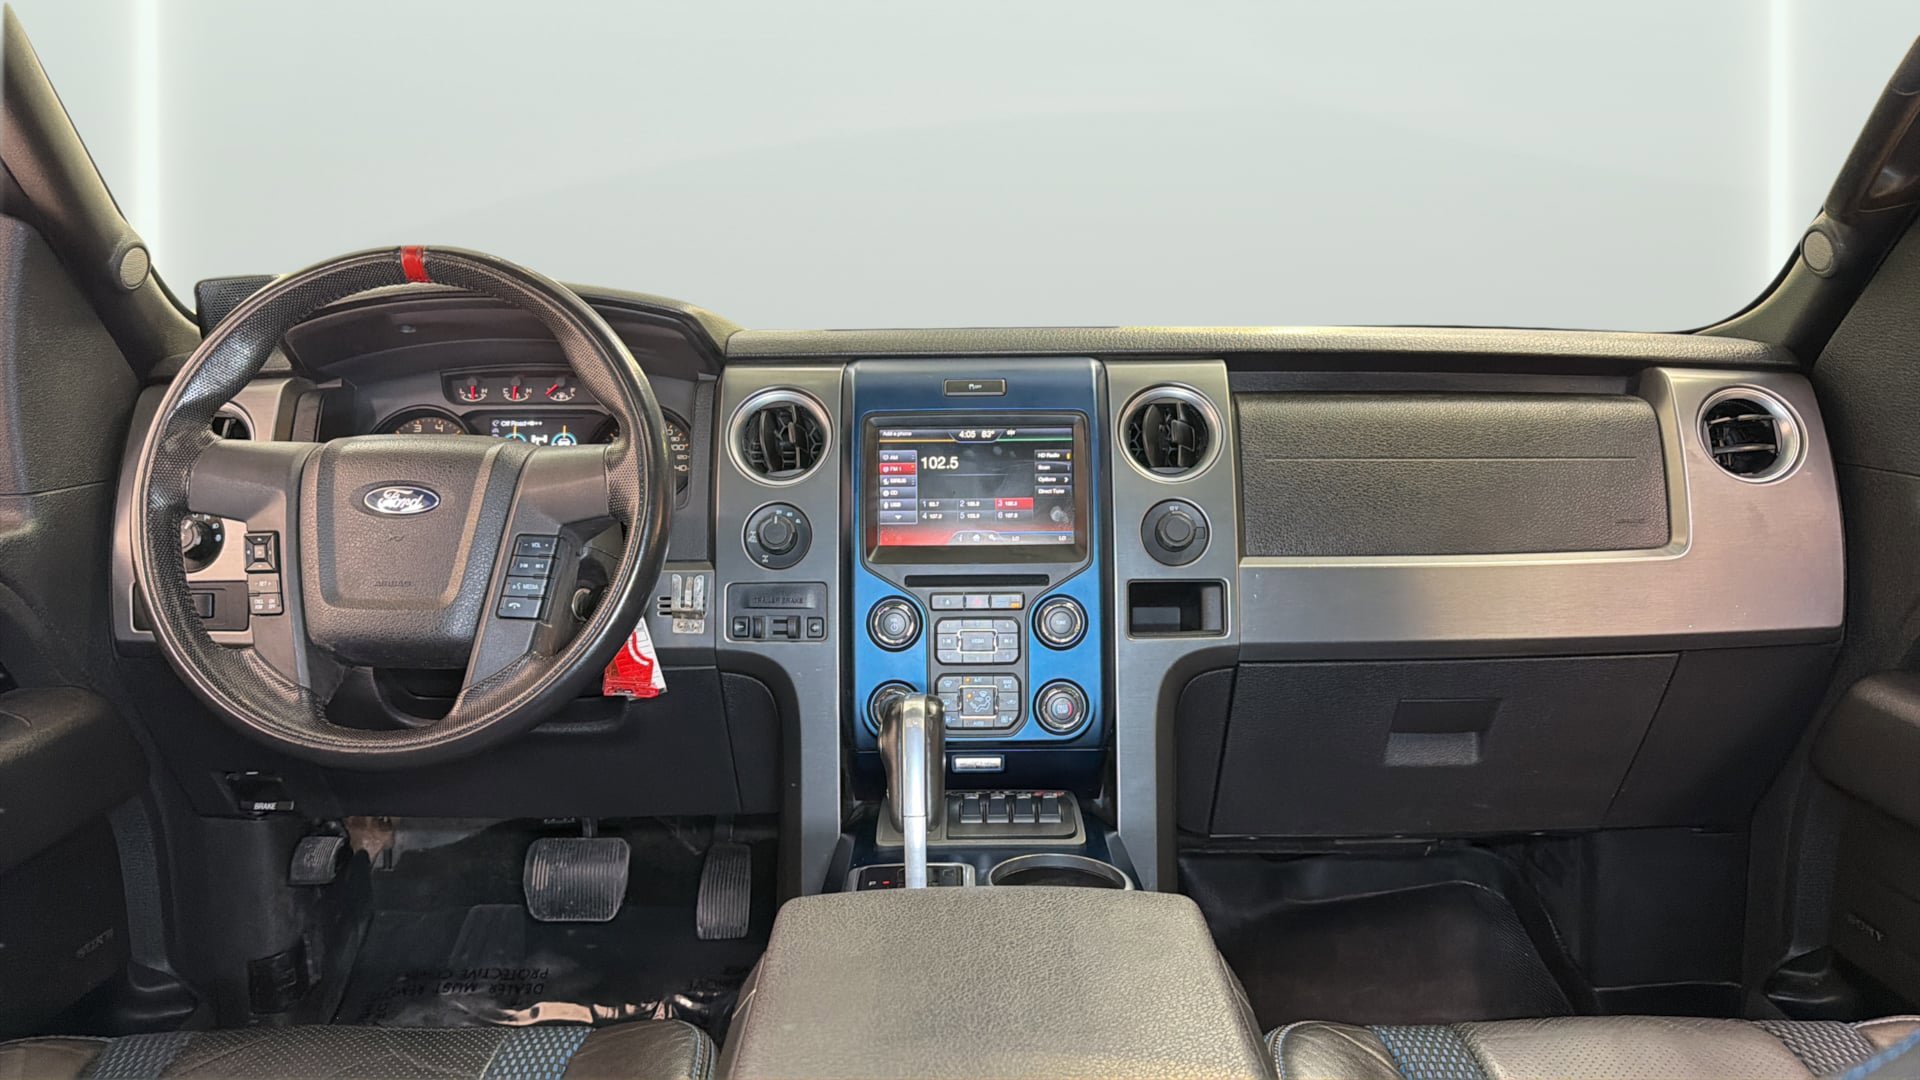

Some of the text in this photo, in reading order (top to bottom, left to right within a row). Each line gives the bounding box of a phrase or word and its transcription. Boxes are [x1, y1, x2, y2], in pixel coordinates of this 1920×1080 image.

[413, 424, 422, 432] 3
[434, 424, 444, 432] 4
[920, 456, 959, 470] 102.5
[376, 489, 425, 512] Ford
[752, 596, 778, 604] TRAILER
[253, 802, 277, 810] BRAKE
[432, 982, 478, 996] MUST
[488, 982, 545, 996] DEALER
